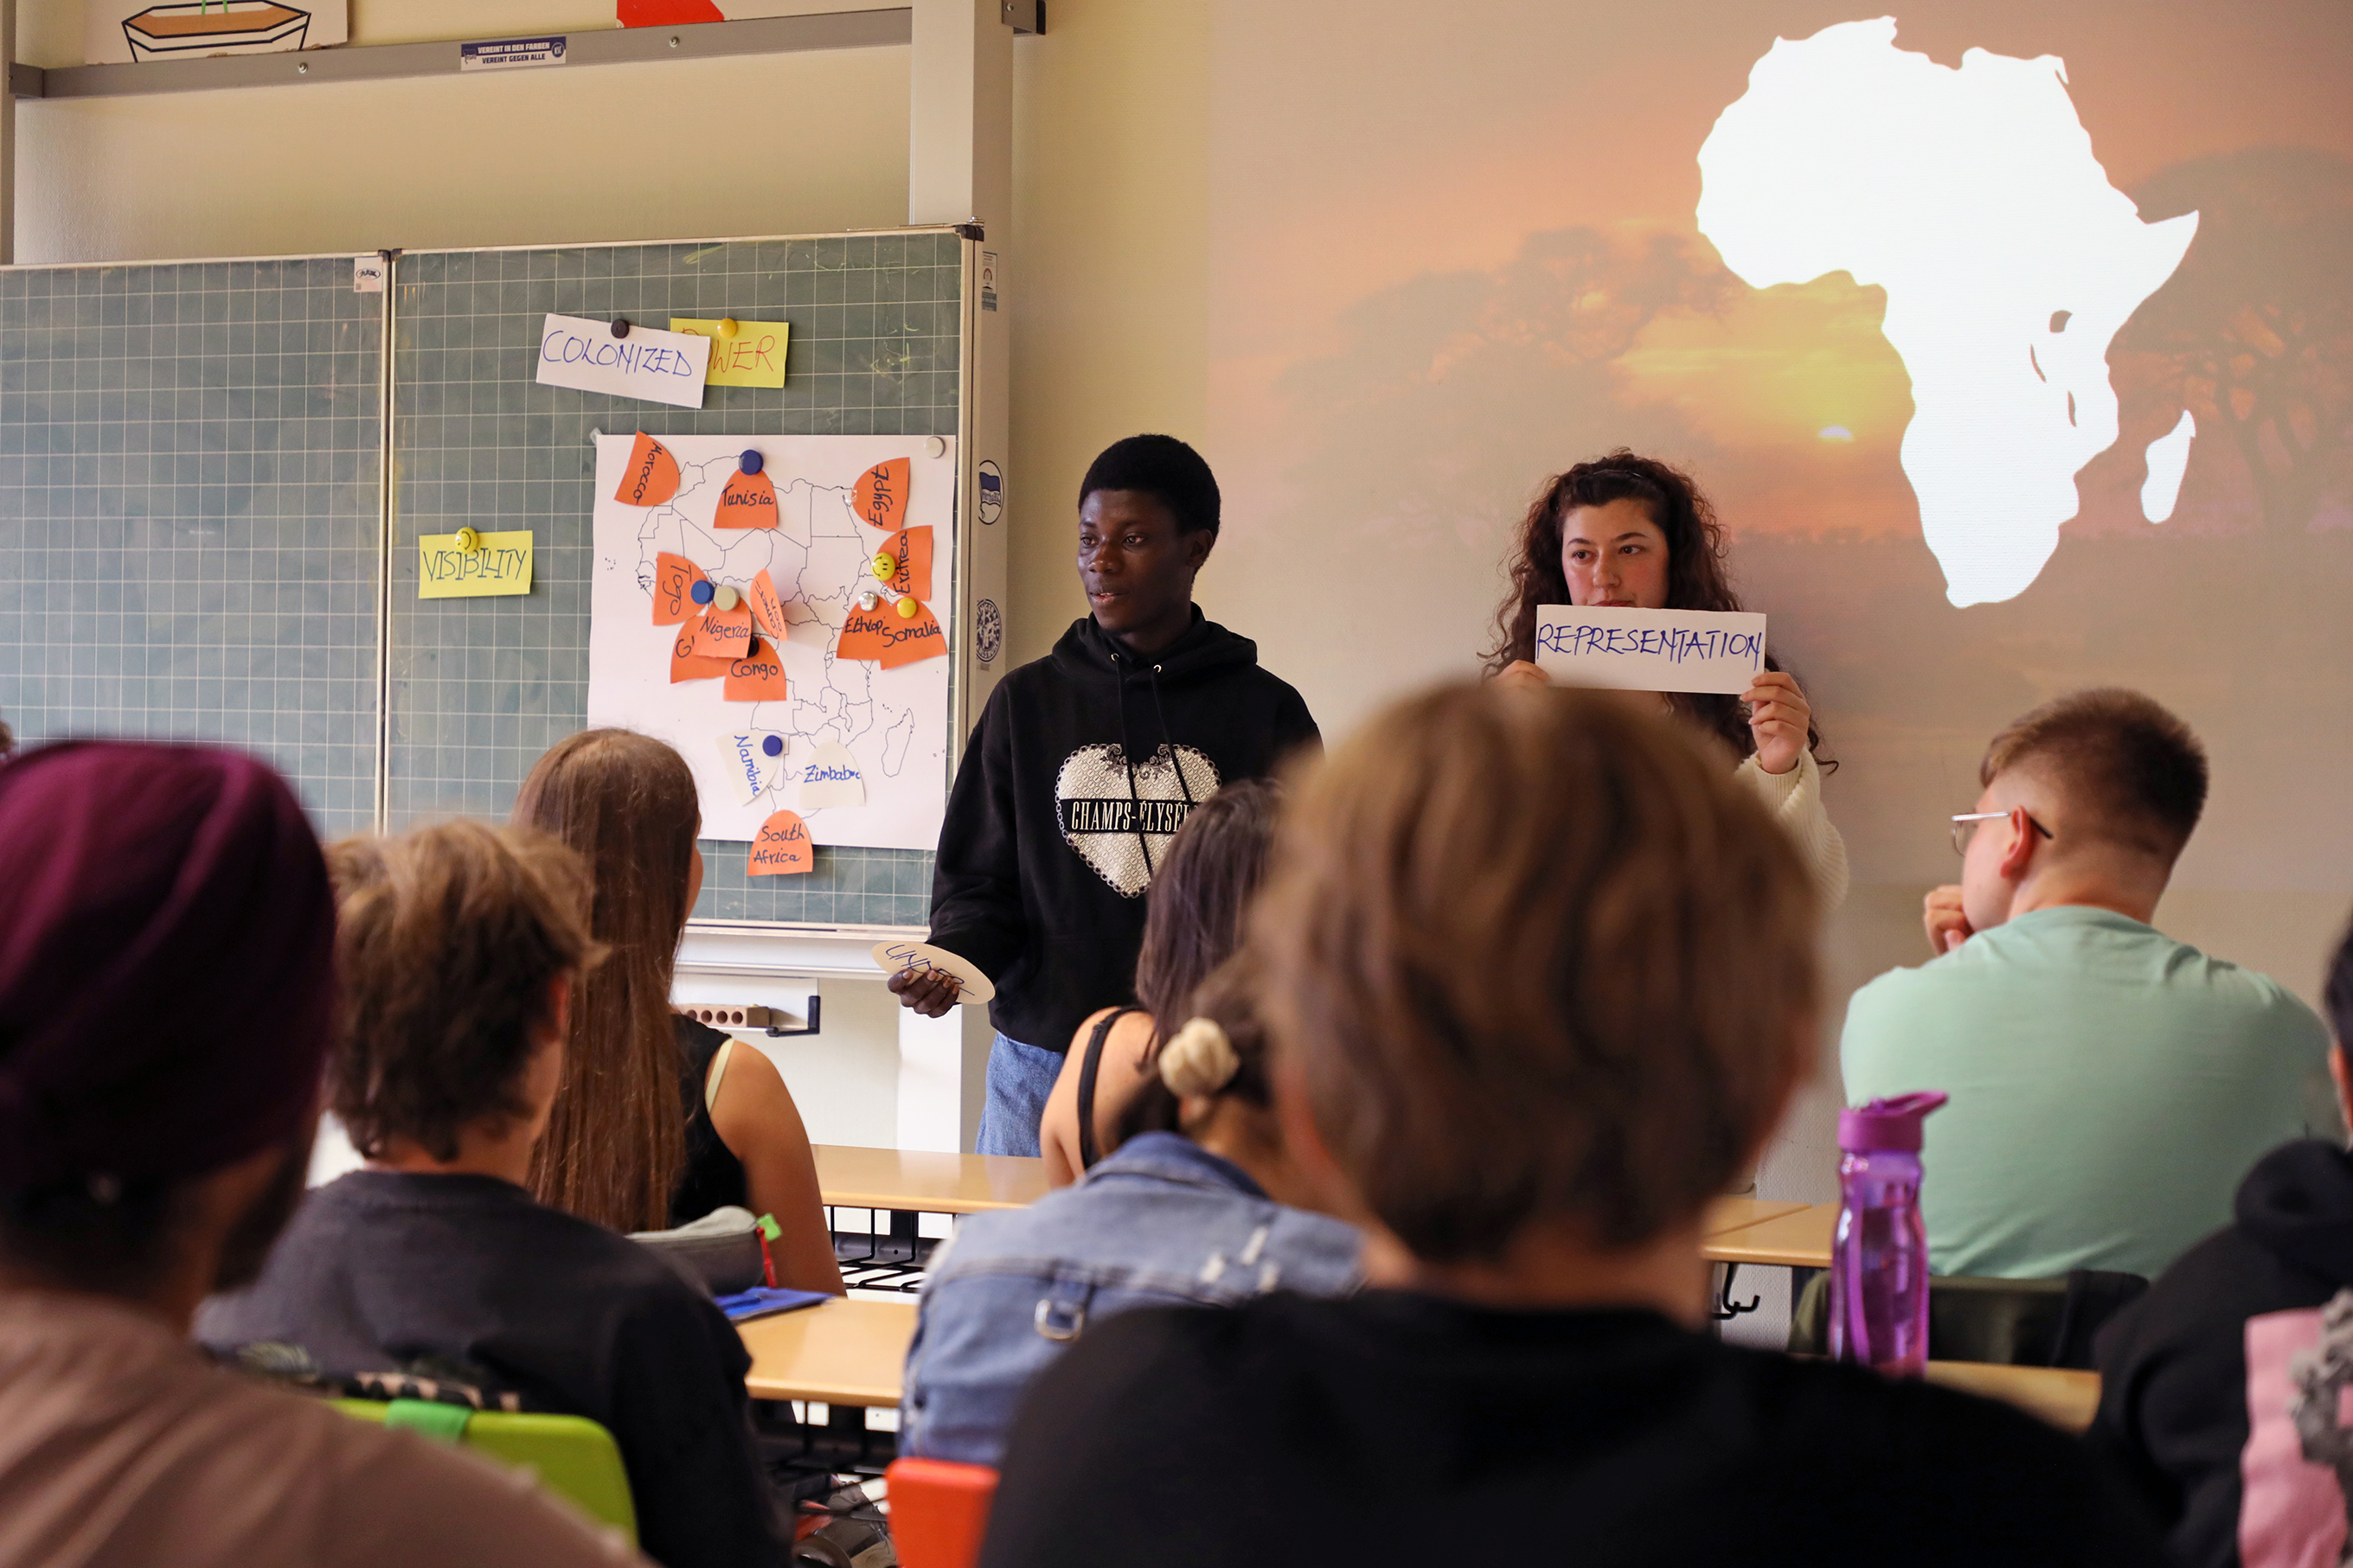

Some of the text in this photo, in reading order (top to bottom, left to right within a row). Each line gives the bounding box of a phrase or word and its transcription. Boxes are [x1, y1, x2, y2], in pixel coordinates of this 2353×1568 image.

[478, 46, 503, 54] VEREINT
[525, 42, 550, 51] FARBEN
[482, 55, 508, 64] VEREINT
[509, 54, 529, 62] GEGEN
[542, 330, 693, 377] COLONIZED
[681, 327, 776, 374] WER
[632, 441, 663, 505] Morocco
[721, 483, 775, 507] Tunisia
[867, 464, 894, 527] Egypt
[422, 547, 527, 582] VISIBILITY
[893, 530, 911, 594] Eritrea
[662, 564, 692, 616] Togo
[699, 616, 751, 642] Nigeria
[882, 619, 942, 648] Somalia
[1536, 623, 1762, 671] REPRESENTATION
[730, 658, 779, 681] Congo
[734, 734, 762, 797] Namibia
[760, 822, 805, 842] South
[753, 847, 802, 865] Africa
